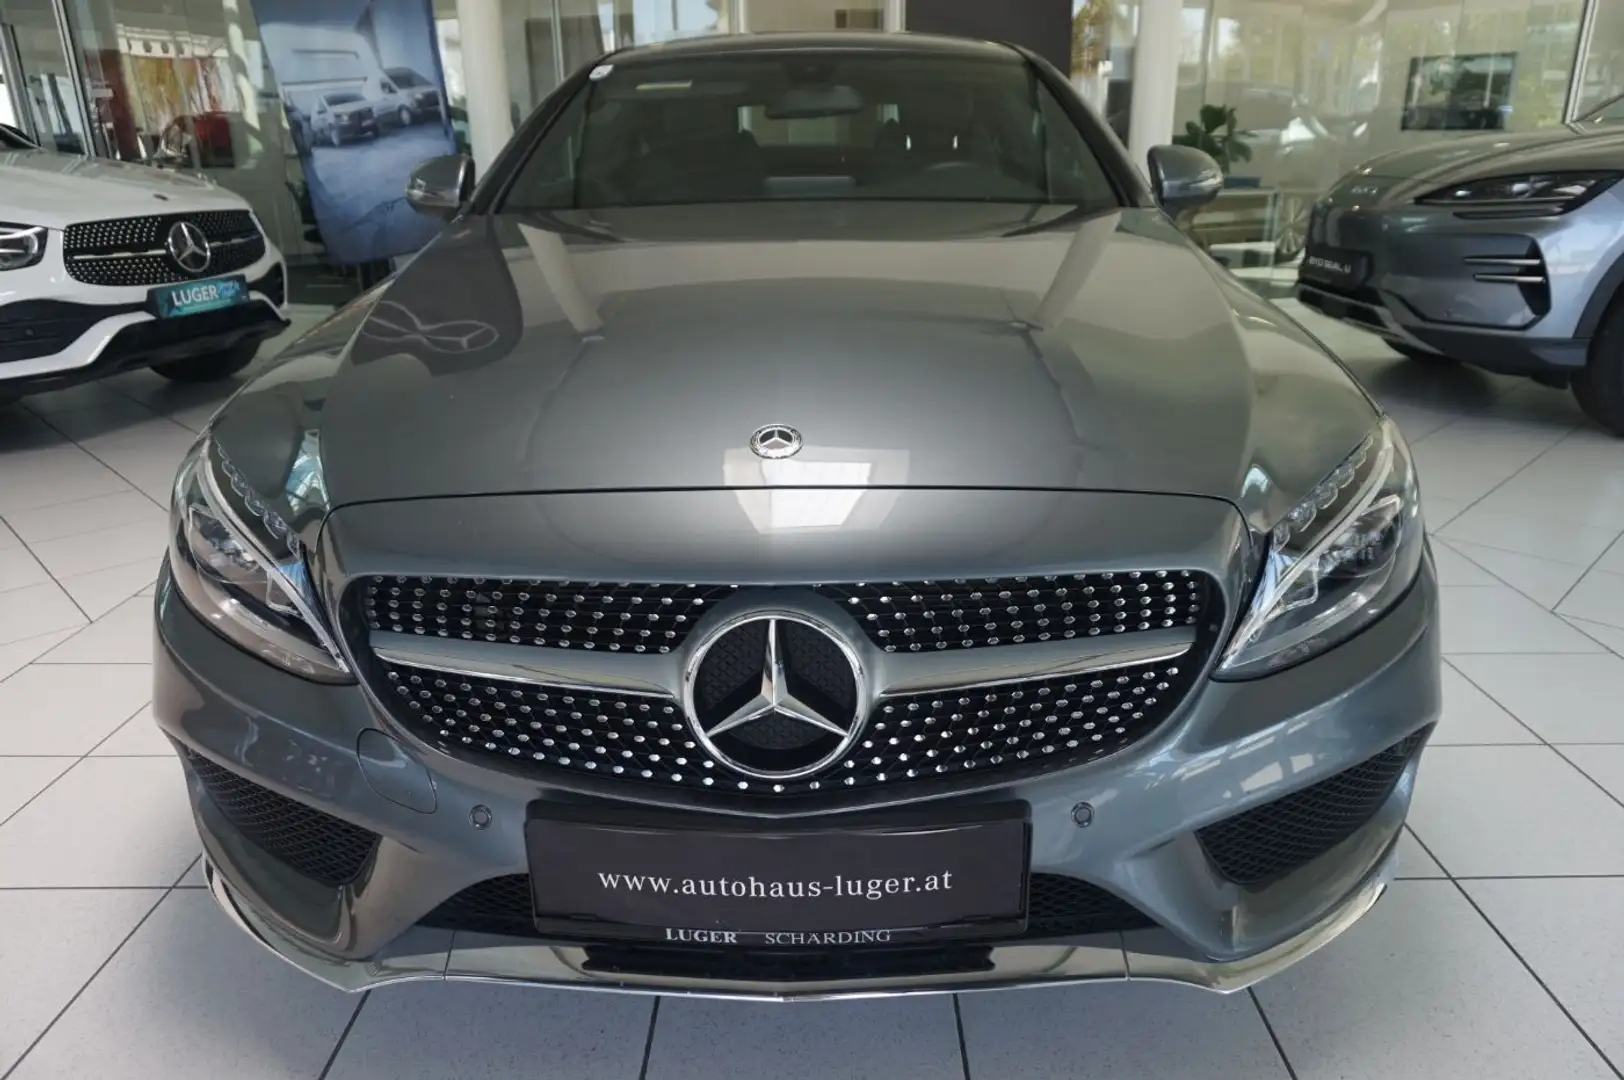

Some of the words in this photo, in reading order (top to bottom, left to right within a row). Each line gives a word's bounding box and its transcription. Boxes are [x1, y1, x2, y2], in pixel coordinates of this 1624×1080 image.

[171, 284, 218, 306] LUGER
[597, 870, 953, 900] www.autohaus-luger.at
[665, 928, 738, 944] LUGER
